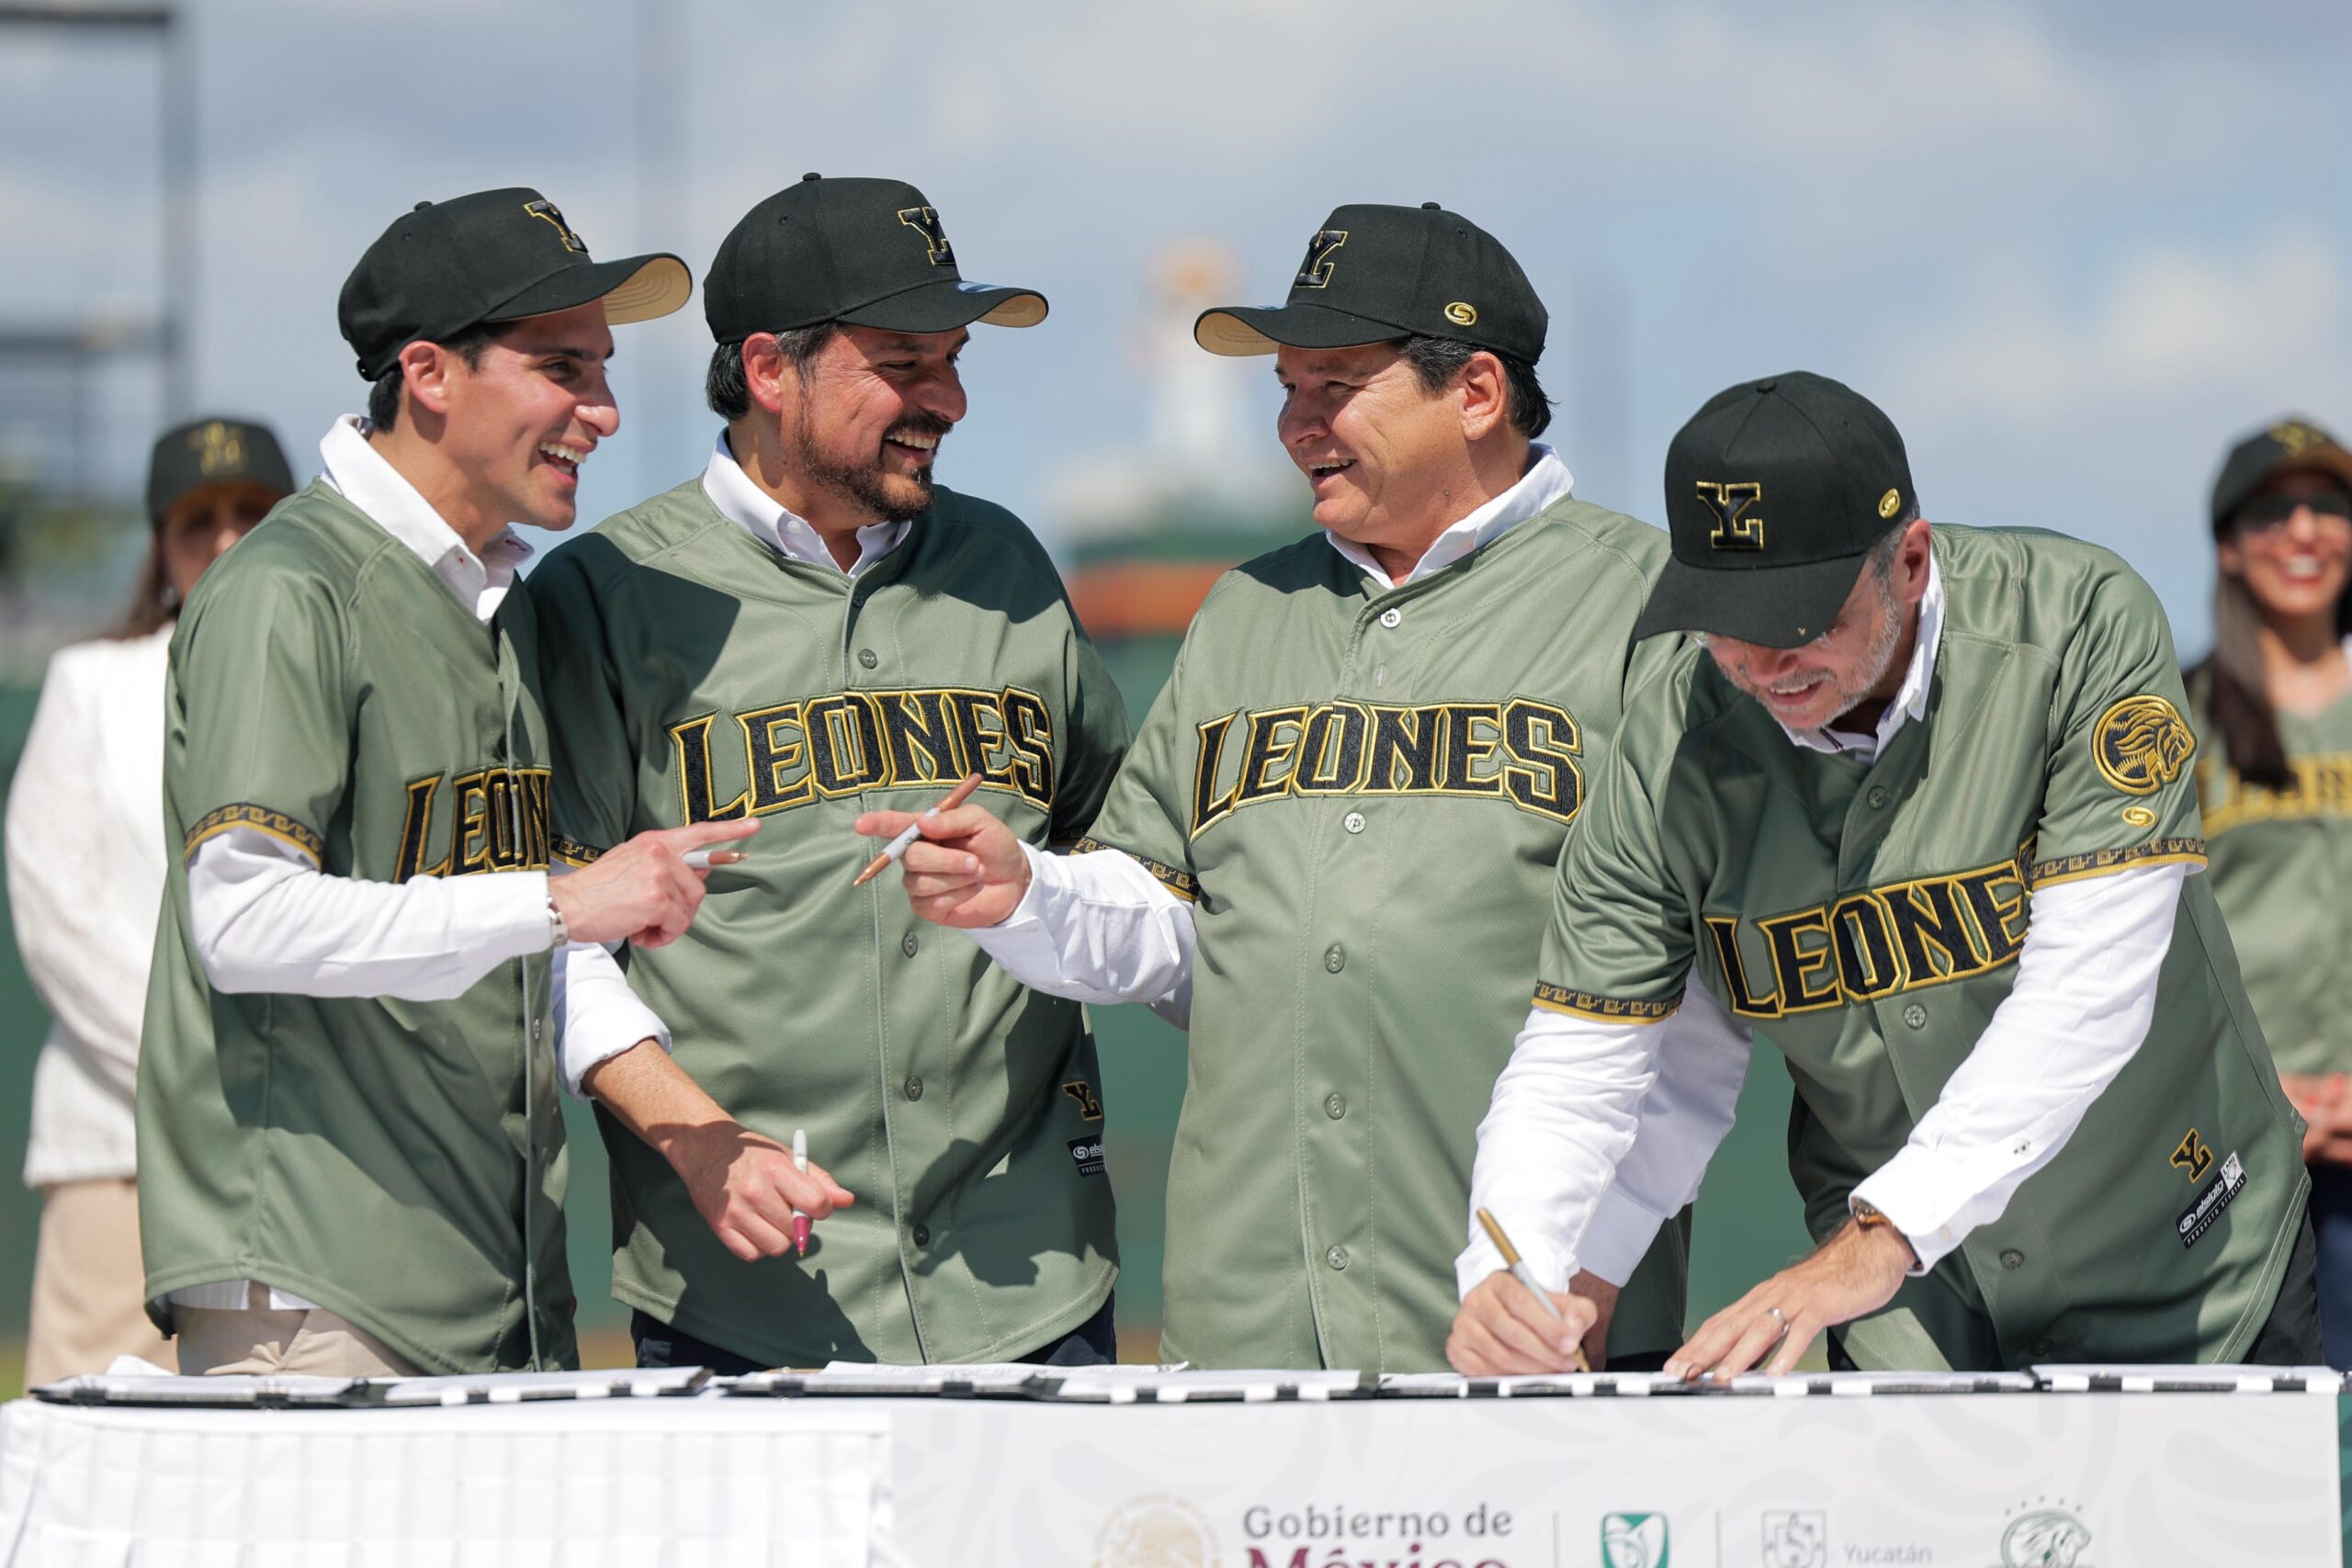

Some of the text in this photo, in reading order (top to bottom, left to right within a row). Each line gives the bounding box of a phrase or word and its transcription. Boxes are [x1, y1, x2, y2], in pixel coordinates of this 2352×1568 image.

[669, 685, 1056, 827] LEONES
[1190, 696, 1586, 843] LEONES
[1702, 832, 2034, 1018] LEONE
[1081, 1163, 1105, 1174] PRODUC
[2187, 1178, 2245, 1246] PRODUCTO OFICIAL
[1243, 1505, 1450, 1539] Gobierno
[1464, 1501, 1514, 1537] de
[1842, 1541, 1934, 1564] Yucatán
